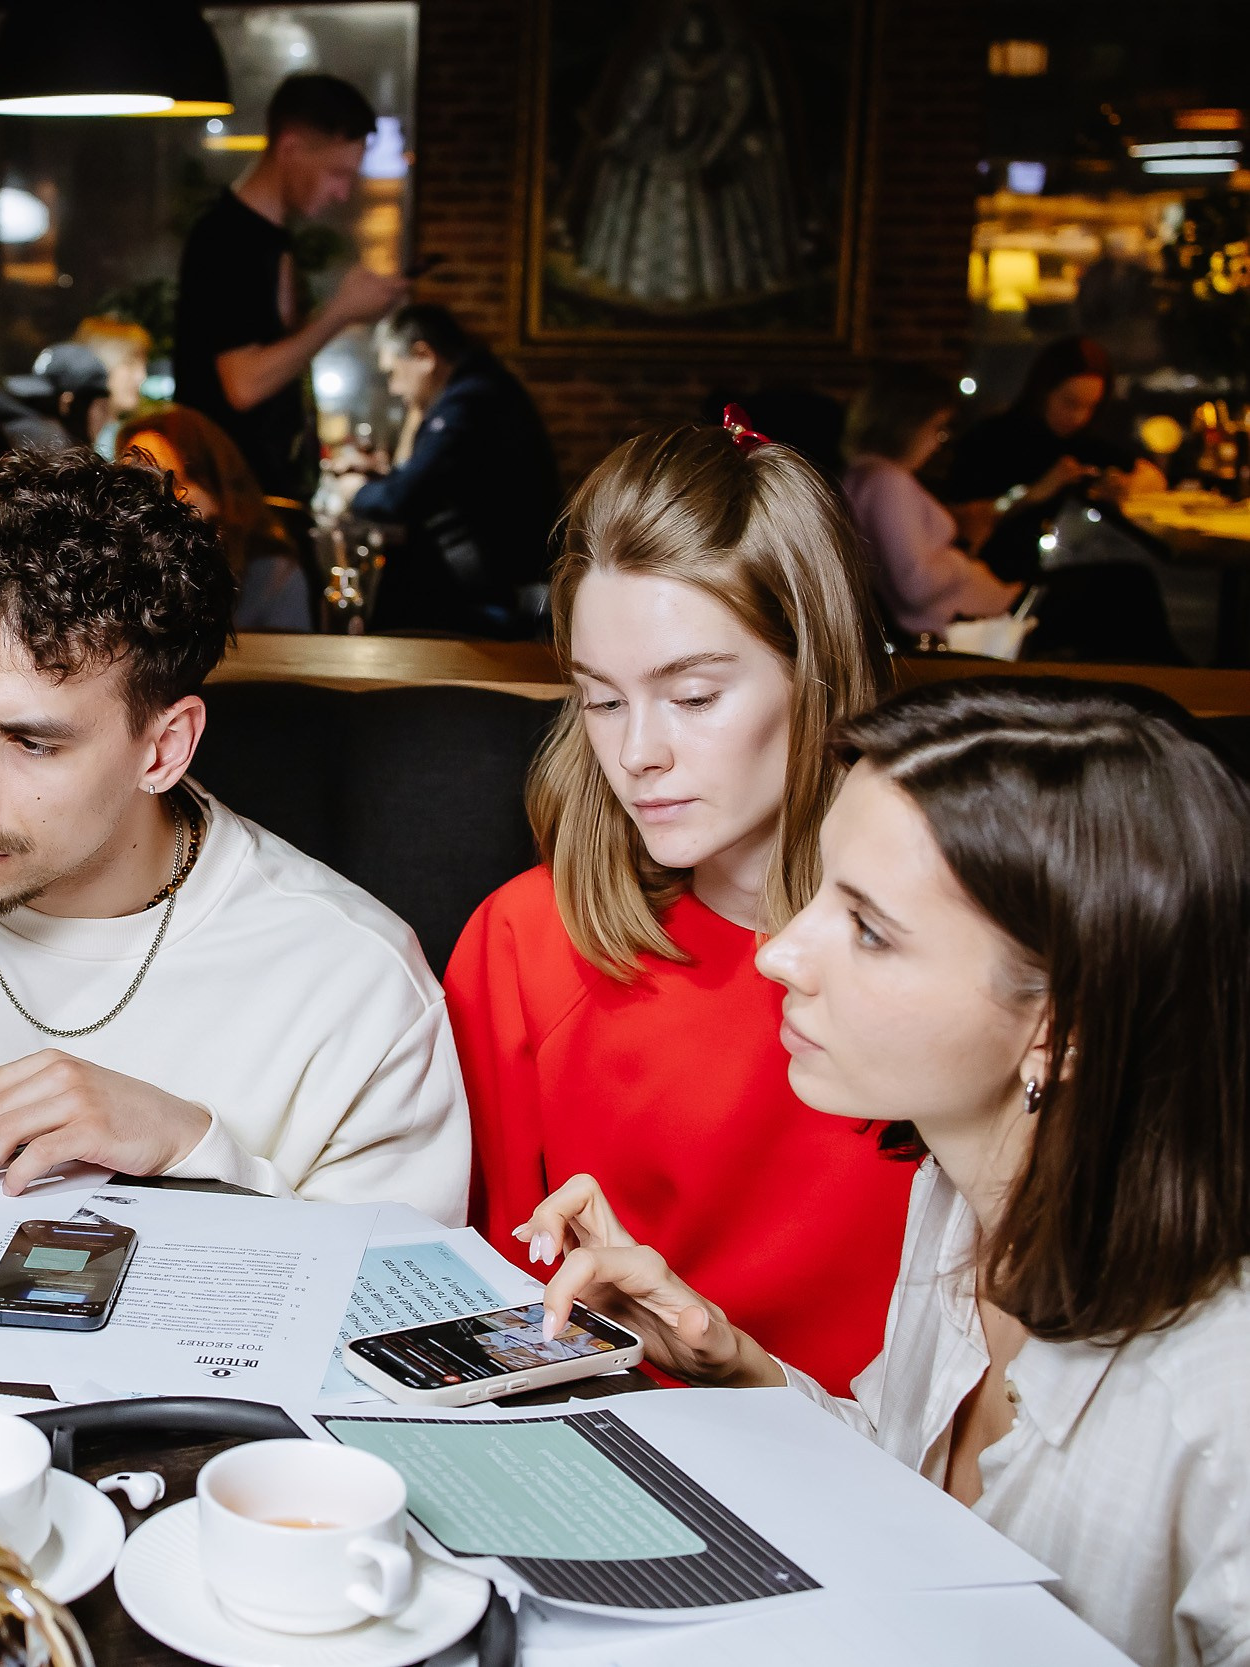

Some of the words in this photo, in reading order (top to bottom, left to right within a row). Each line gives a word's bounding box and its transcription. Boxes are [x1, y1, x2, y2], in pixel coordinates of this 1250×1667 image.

[177, 1339, 234, 1349] SECRET
[236, 1343, 264, 1351] TOP
[193, 1355, 260, 1368] DETECTIT
